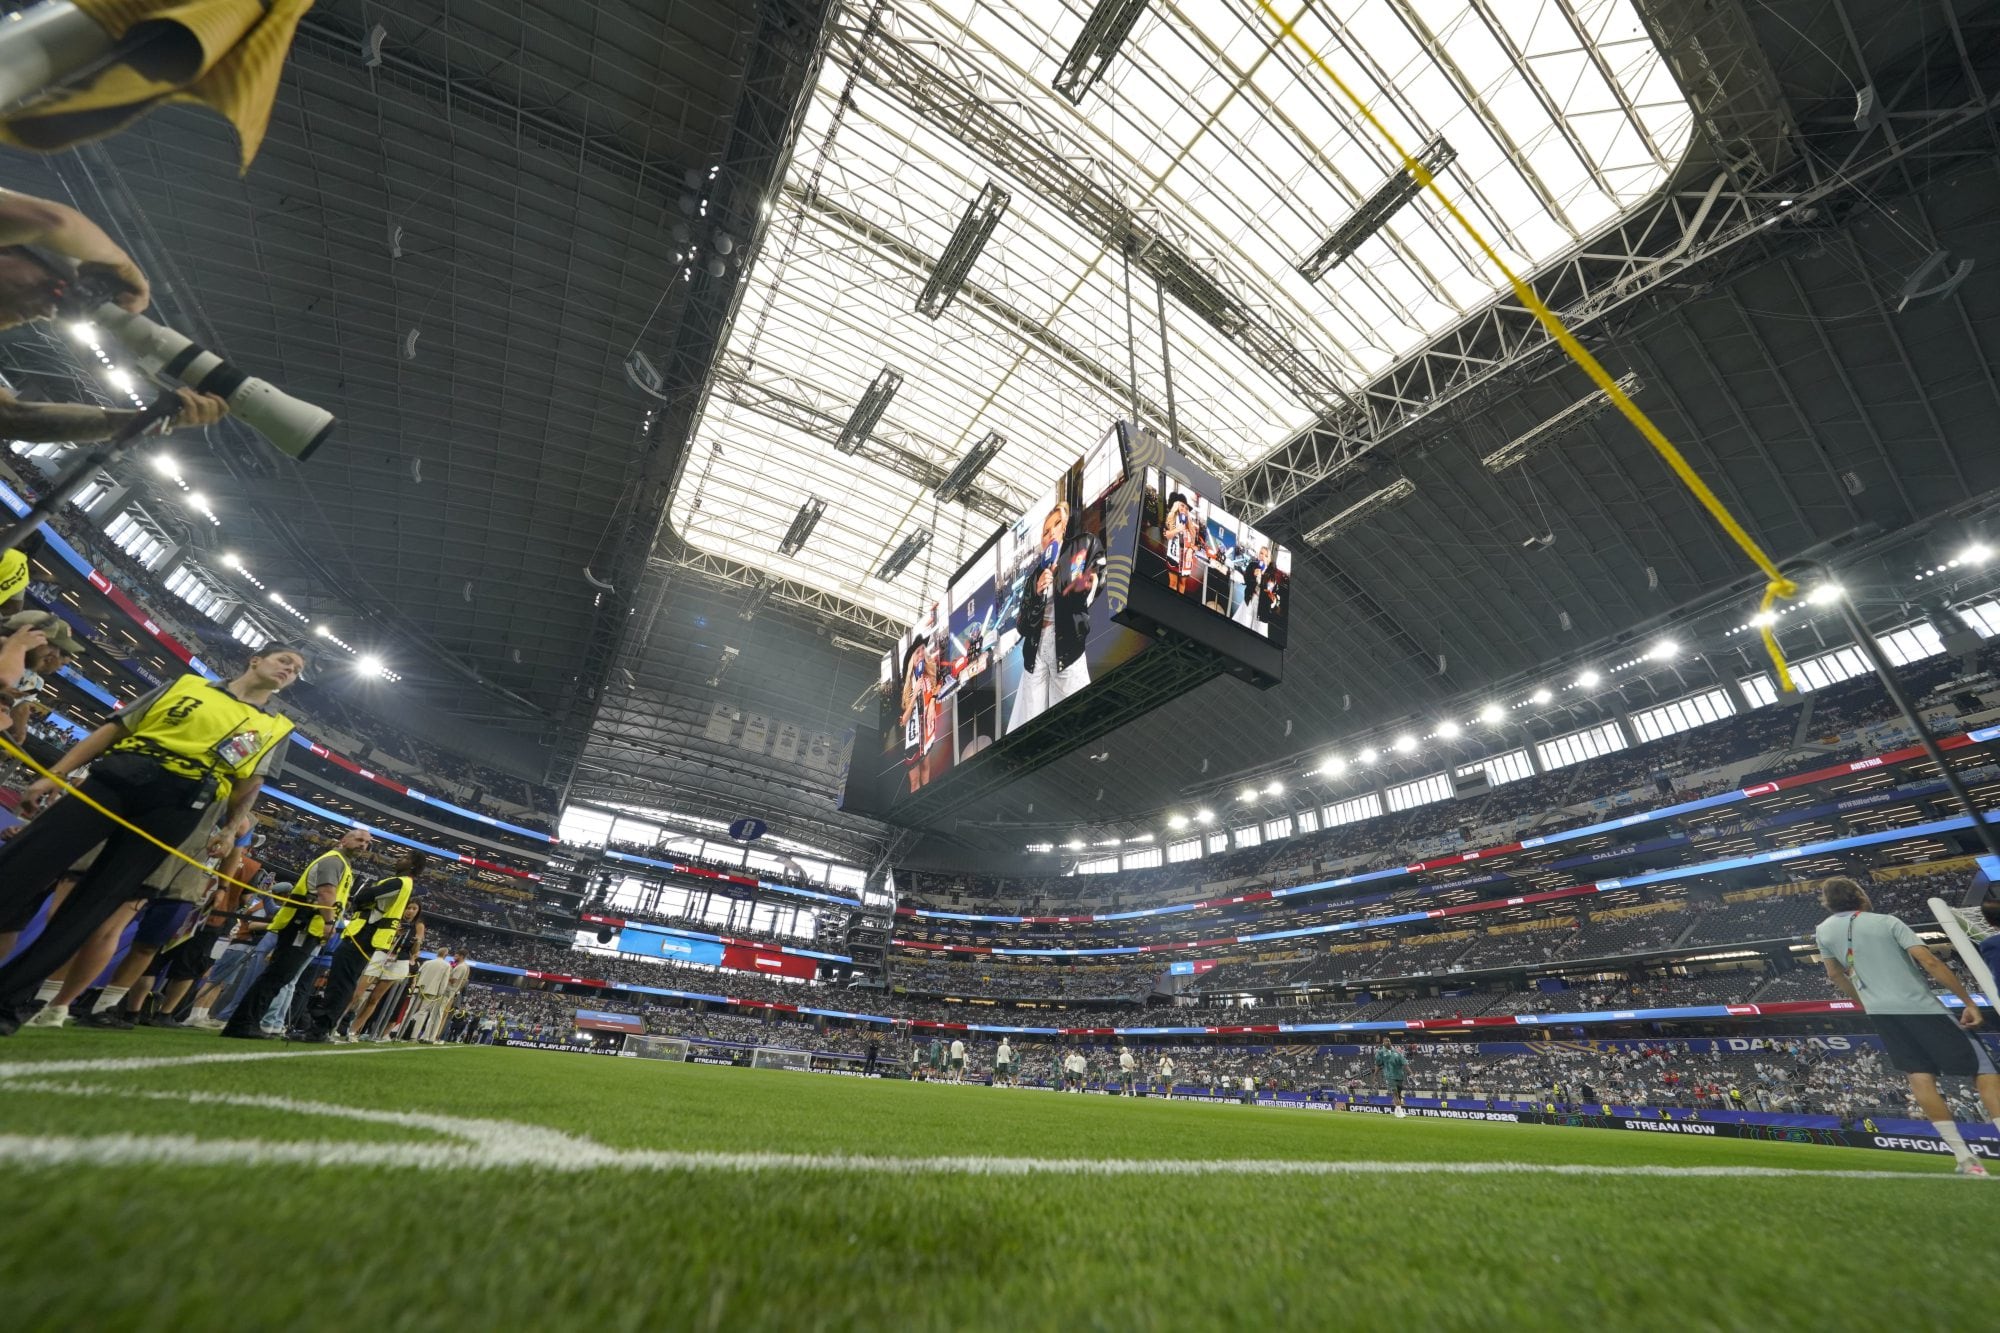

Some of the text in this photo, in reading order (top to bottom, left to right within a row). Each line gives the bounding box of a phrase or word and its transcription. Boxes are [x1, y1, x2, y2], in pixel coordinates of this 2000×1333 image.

[1850, 758, 1883, 771] AUSTRIA
[1592, 847, 1636, 860] DALLAS
[506, 1040, 538, 1048] OFFICIAL
[539, 1043, 570, 1051] PLAYLIST
[1728, 1036, 1851, 1051] DAAS
[694, 1057, 718, 1065] STREAM
[1256, 1099, 1333, 1111] UNITED STATES OF AMERICA
[1349, 1105, 1516, 1122] OFFICIAL PLLIST FIFA WORLD CUP 2026
[1625, 1120, 1715, 1135] STREAM NOW
[1873, 1136, 1956, 1154] OFFICIA
